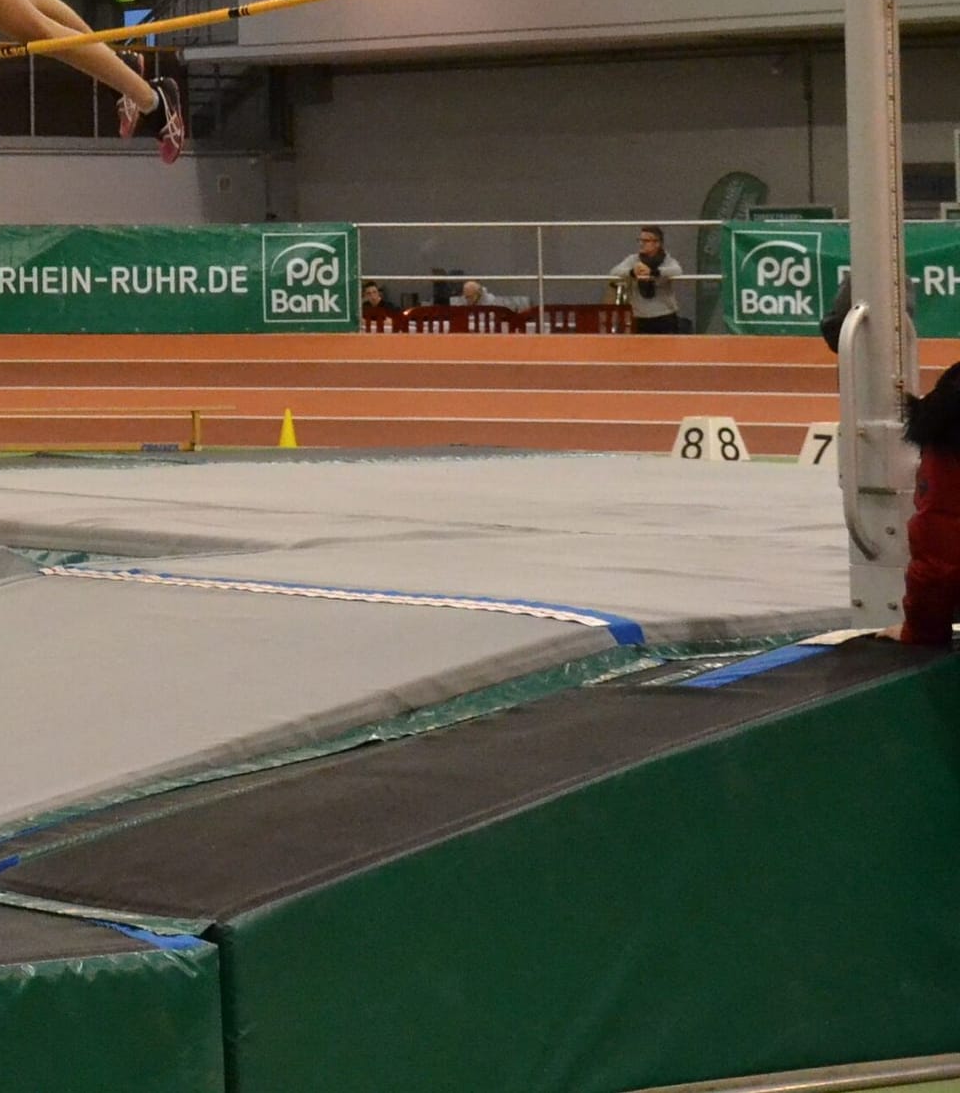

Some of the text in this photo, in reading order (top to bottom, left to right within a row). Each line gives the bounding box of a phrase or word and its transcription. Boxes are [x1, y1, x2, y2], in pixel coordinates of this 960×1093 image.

[285, 256, 339, 287] psd
[757, 256, 812, 287] psd
[271, 288, 341, 314] Bank
[741, 288, 814, 316] Bank
[681, 427, 704, 460] 8
[717, 426, 740, 461] 8
[812, 433, 833, 465] 7
